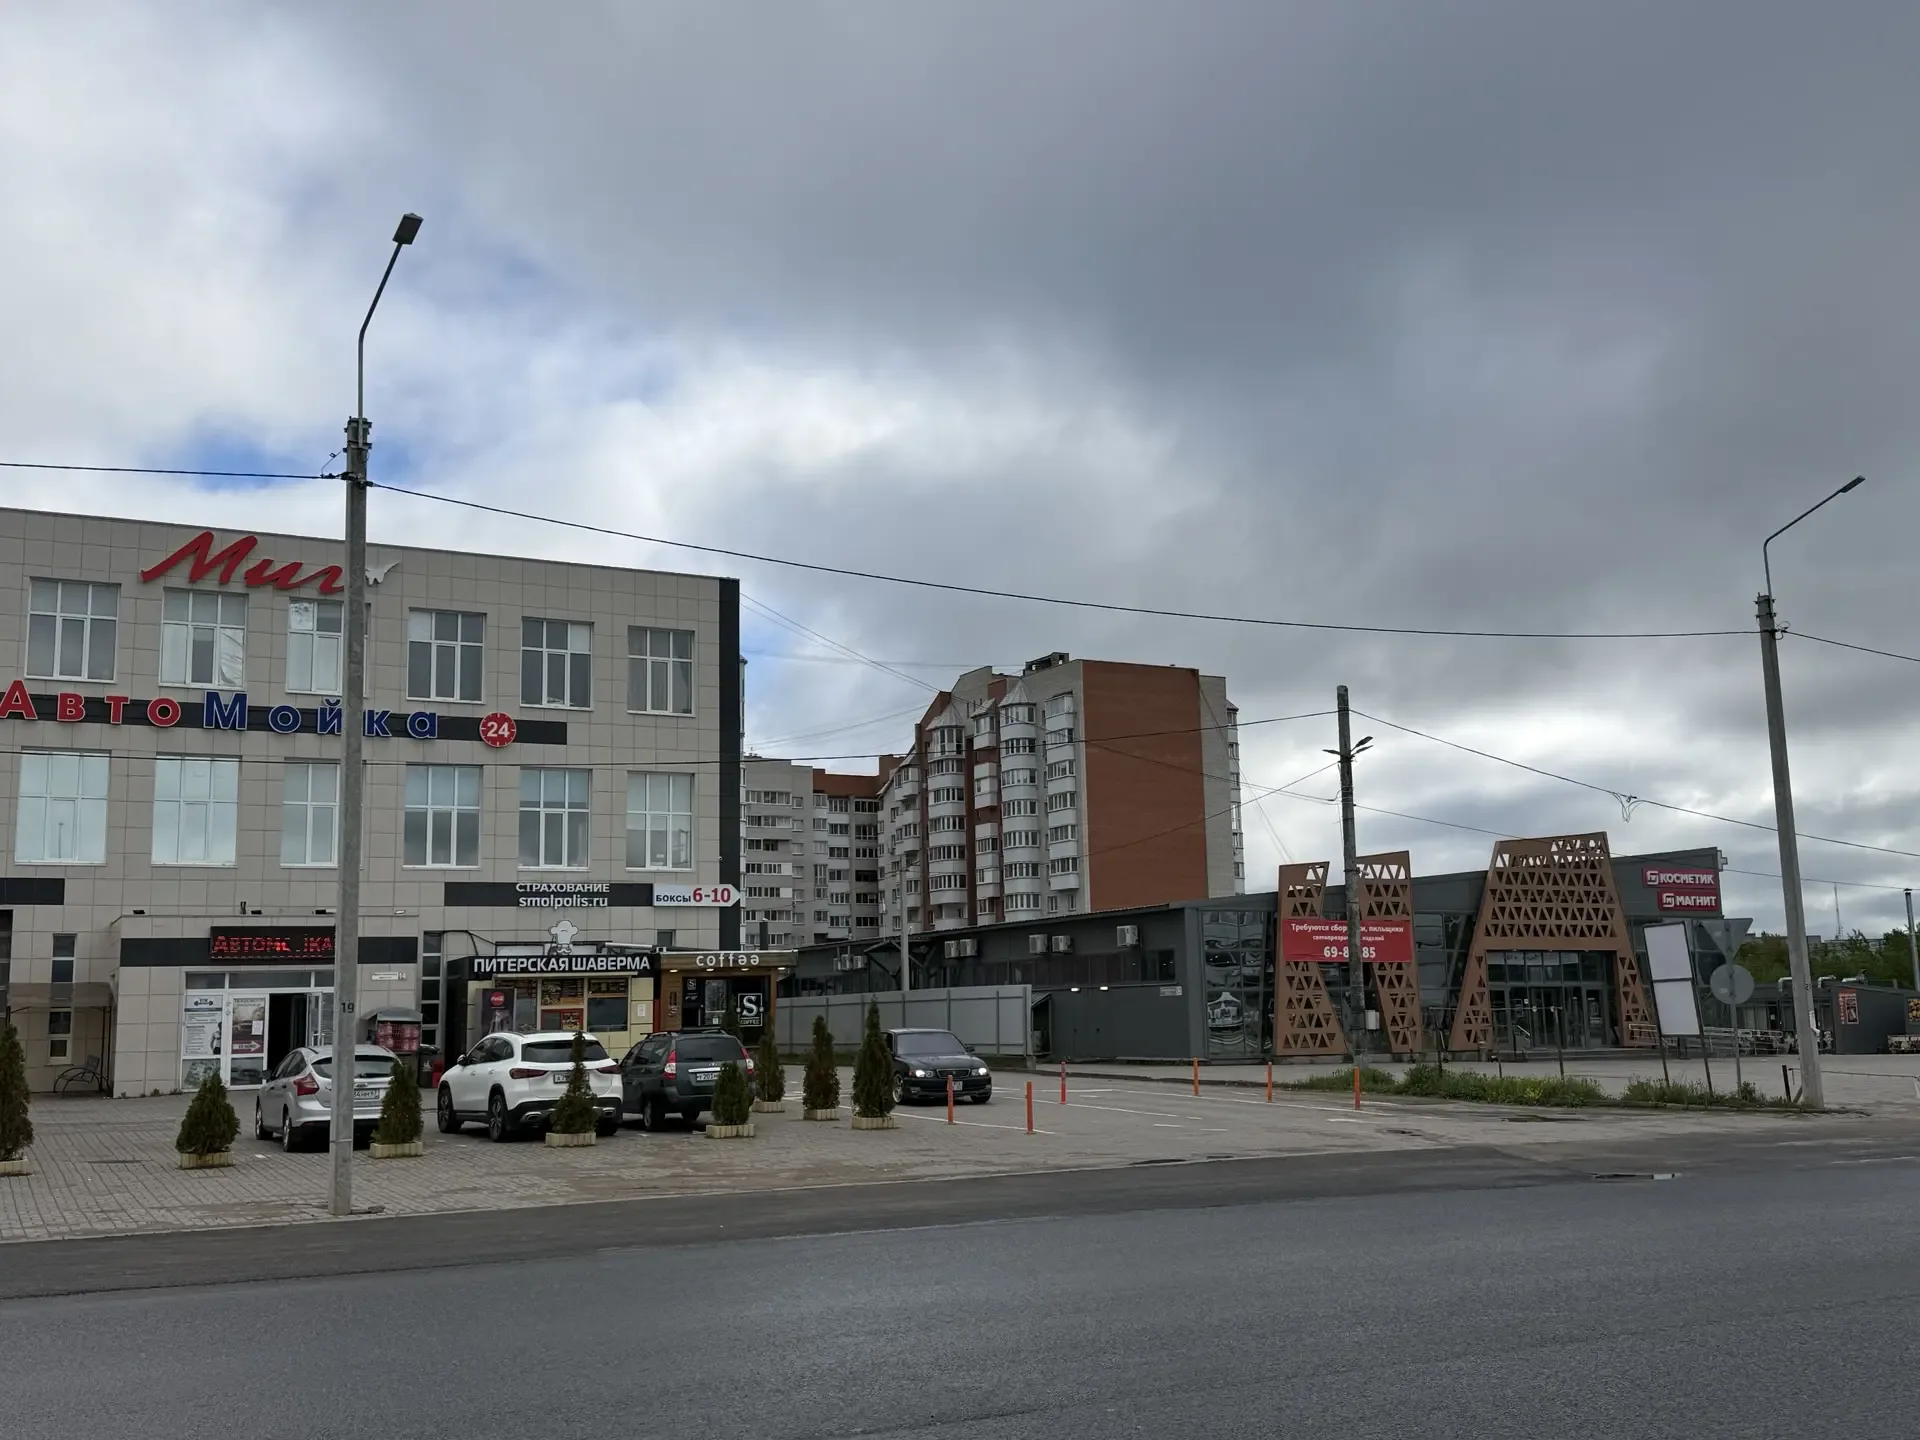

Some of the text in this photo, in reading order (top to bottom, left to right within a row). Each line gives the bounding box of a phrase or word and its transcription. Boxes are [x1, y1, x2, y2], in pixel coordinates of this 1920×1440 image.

[140, 531, 345, 595] Миг
[486, 721, 510, 738] 24
[1659, 873, 1715, 885] КОСМЕТИК
[515, 883, 611, 893] СТРАХОВАНИЕ
[692, 887, 731, 903] 6-10
[518, 894, 609, 911] smolpolis.ru
[1676, 896, 1717, 906] МАГНИТ
[1291, 923, 1329, 932] Требуются
[473, 956, 650, 973] ПИТЕРСКАЯ ШАВЕРМА
[341, 1002, 355, 1013] 19
[742, 995, 759, 1017] S
